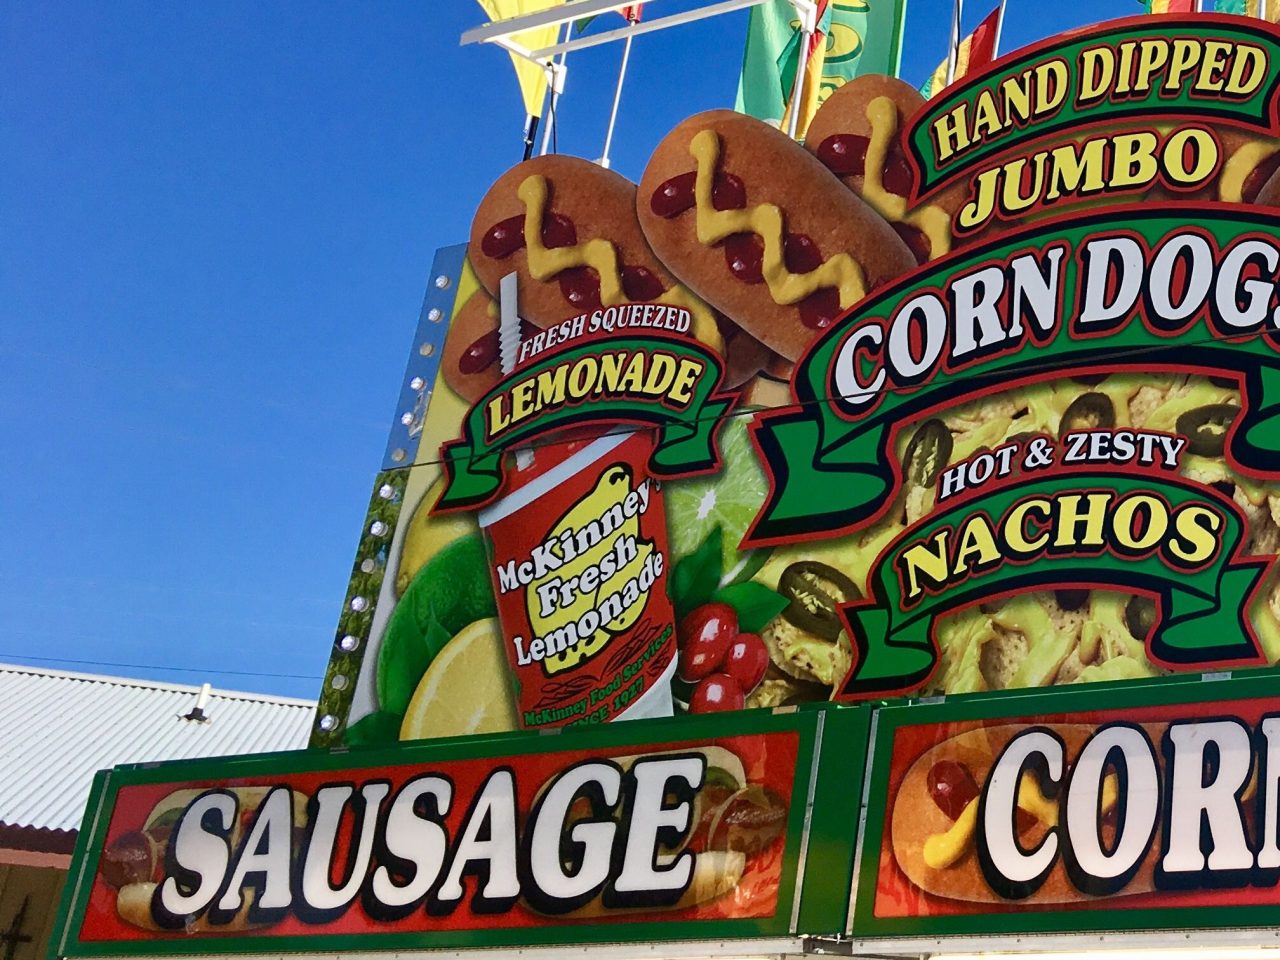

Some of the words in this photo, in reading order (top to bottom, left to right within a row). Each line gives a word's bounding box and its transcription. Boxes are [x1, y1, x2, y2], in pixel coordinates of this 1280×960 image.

[935, 58, 1069, 161] HAND
[1077, 38, 1268, 101] DIPPED
[960, 128, 1217, 229] JUMBO
[517, 317, 584, 365] FRESH
[588, 304, 692, 333] SQUEEZED
[834, 247, 1065, 406] CORN
[488, 353, 702, 436] LEMONADE
[941, 443, 1019, 500] HOT
[1027, 439, 1054, 467] &
[1066, 431, 1187, 468] ZESTY
[536, 534, 638, 619] Fresh
[902, 494, 1222, 599] NACHOS
[513, 552, 664, 666] Lemonade
[524, 698, 588, 726] McKinney
[589, 674, 623, 706] Food
[622, 624, 674, 682] Services
[613, 676, 645, 711] 1927
[158, 755, 706, 918] SAUSAGE
